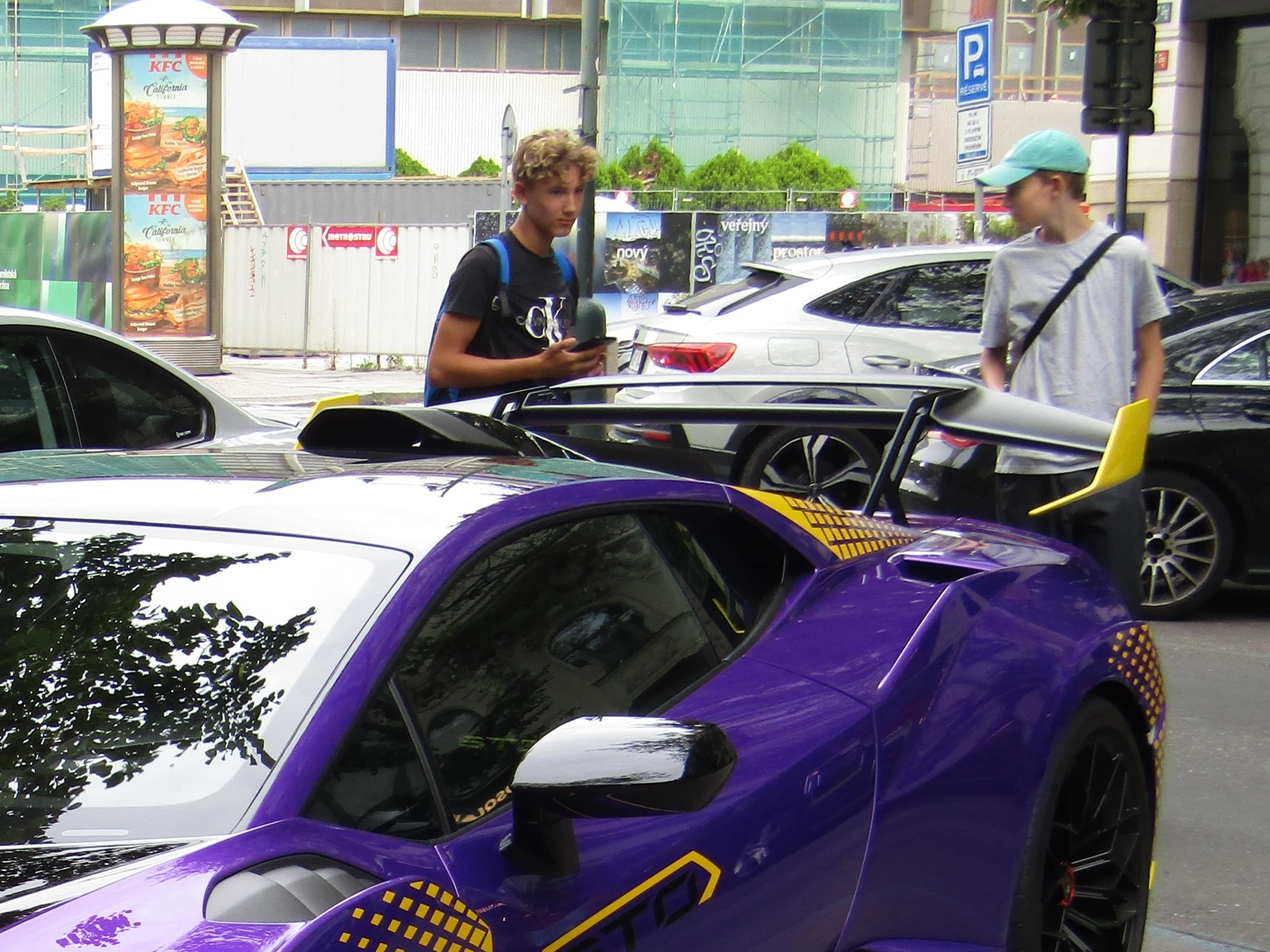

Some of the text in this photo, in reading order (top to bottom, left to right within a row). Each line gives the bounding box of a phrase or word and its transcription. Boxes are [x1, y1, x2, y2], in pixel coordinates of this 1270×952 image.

[964, 34, 984, 80] P
[148, 61, 183, 73] KFC
[143, 82, 188, 97] California
[959, 81, 988, 96] RÉSERVÉ
[147, 204, 181, 216] KFC
[142, 225, 186, 239] California
[721, 218, 769, 234] veřejný
[617, 245, 649, 260] nový
[771, 246, 825, 262] prostor
